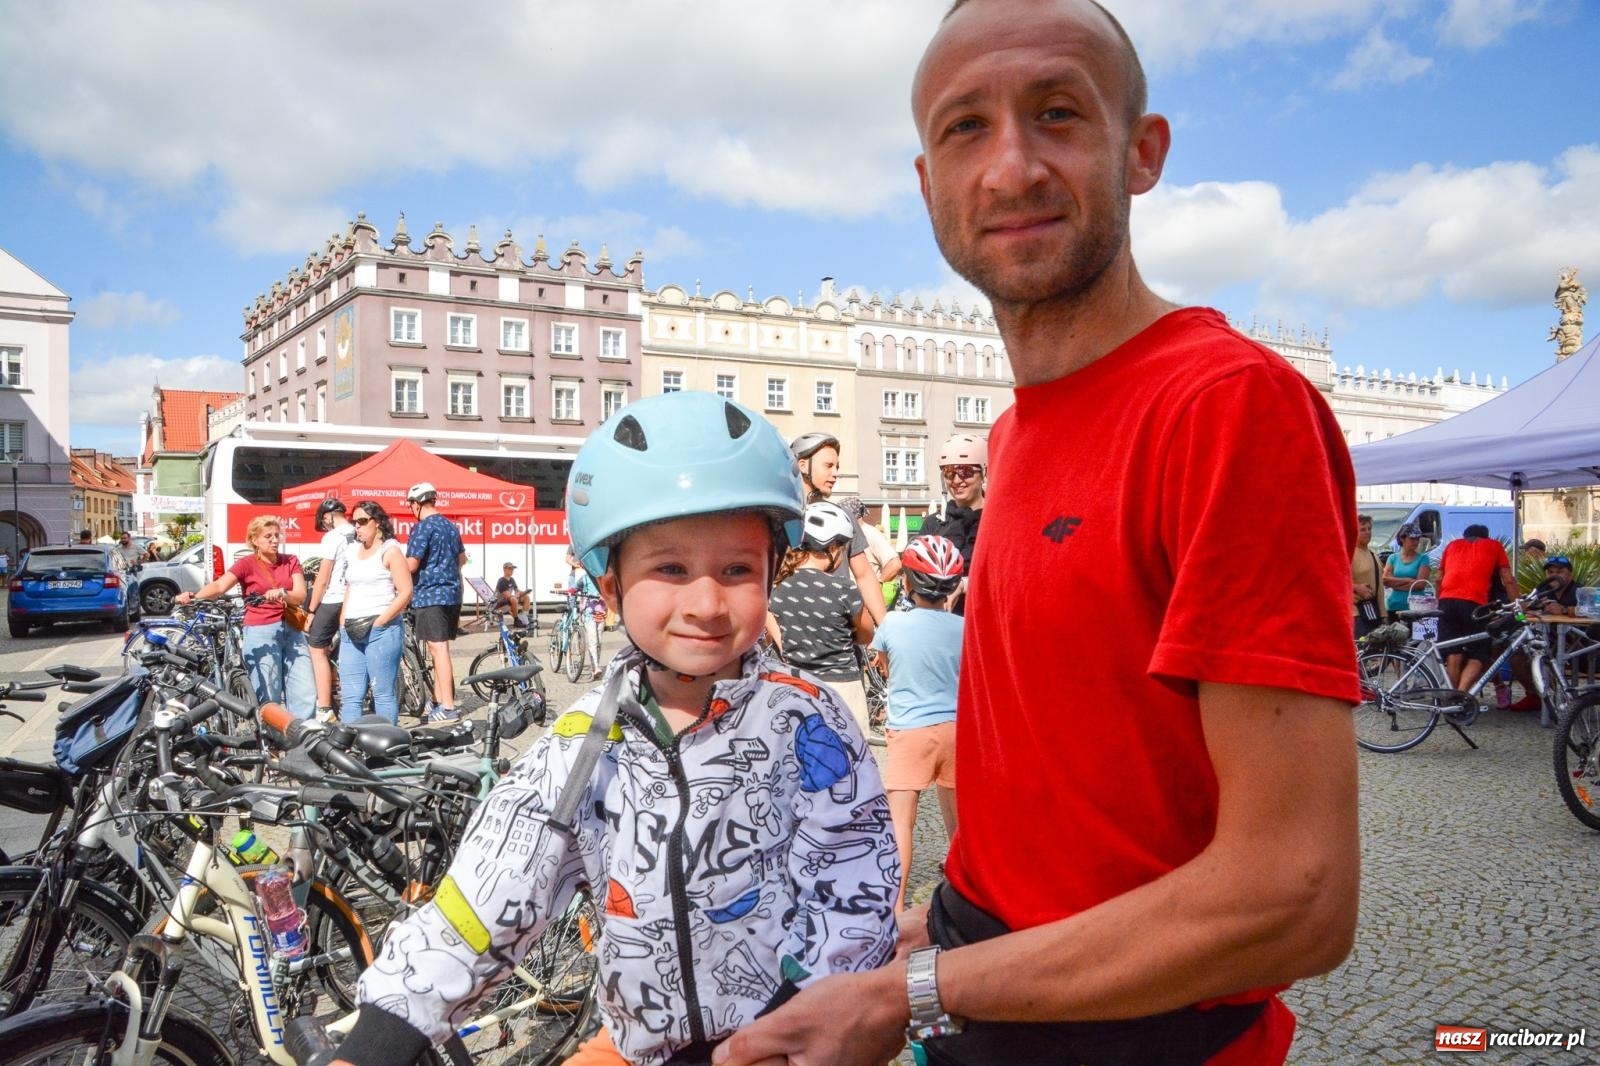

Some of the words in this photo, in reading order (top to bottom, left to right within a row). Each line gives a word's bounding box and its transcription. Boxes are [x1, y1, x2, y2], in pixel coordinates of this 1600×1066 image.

[574, 472, 595, 486] uvex
[491, 518, 557, 539] poboru
[1041, 516, 1083, 544] 4F
[243, 914, 286, 1046] FORMULA
